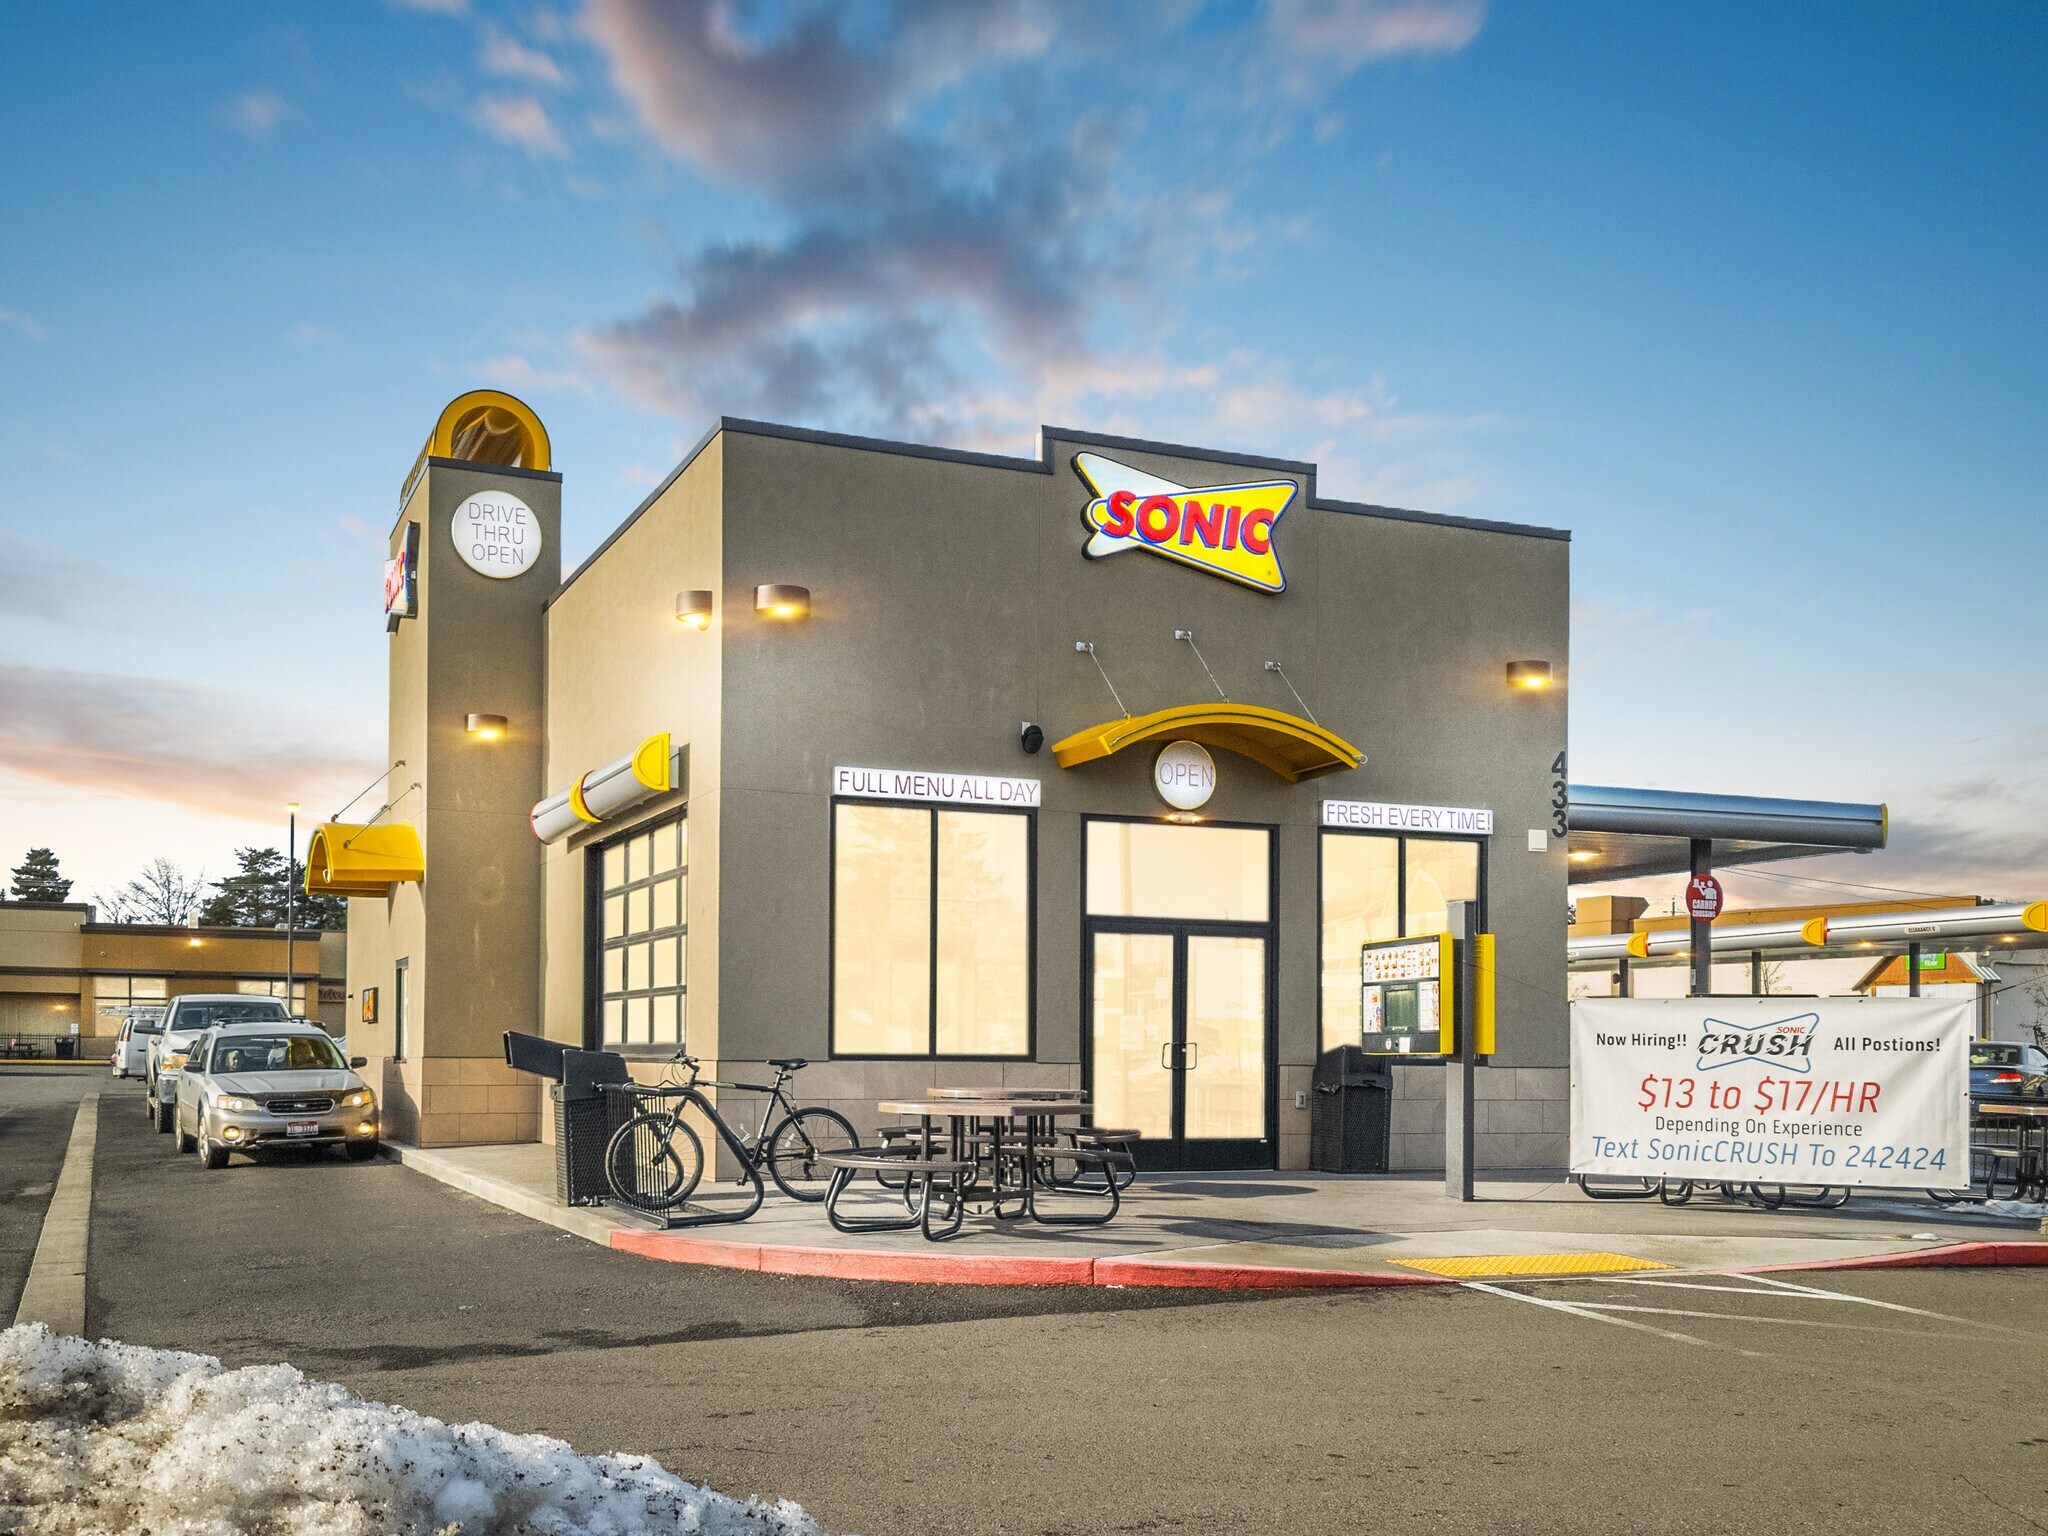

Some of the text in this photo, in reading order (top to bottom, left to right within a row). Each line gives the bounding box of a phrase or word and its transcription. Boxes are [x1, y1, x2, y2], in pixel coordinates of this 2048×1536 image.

[468, 502, 526, 525] DRIVE
[1100, 489, 1275, 556] SONIC
[471, 522, 524, 545] THRU
[472, 543, 524, 565] OPEN
[839, 770, 1039, 803] FULL MENU ALL DAY
[1160, 762, 1214, 788] OPEN
[1551, 750, 1568, 838] 433
[1326, 803, 1491, 831] FRESH EVERY TIME!
[1692, 899, 1718, 910] CARHOP
[1596, 1032, 1687, 1050] Now Hiring!!
[1776, 1026, 1806, 1034] SONIC
[1697, 1032, 1815, 1057] CRUSH
[1834, 1037, 1941, 1052] All Postions!
[1638, 1074, 1881, 1115] $13 to $17/HR
[1655, 1116, 1863, 1138] Depending On Experience
[1592, 1136, 1947, 1171] Text SonicCRUSH To 242424
